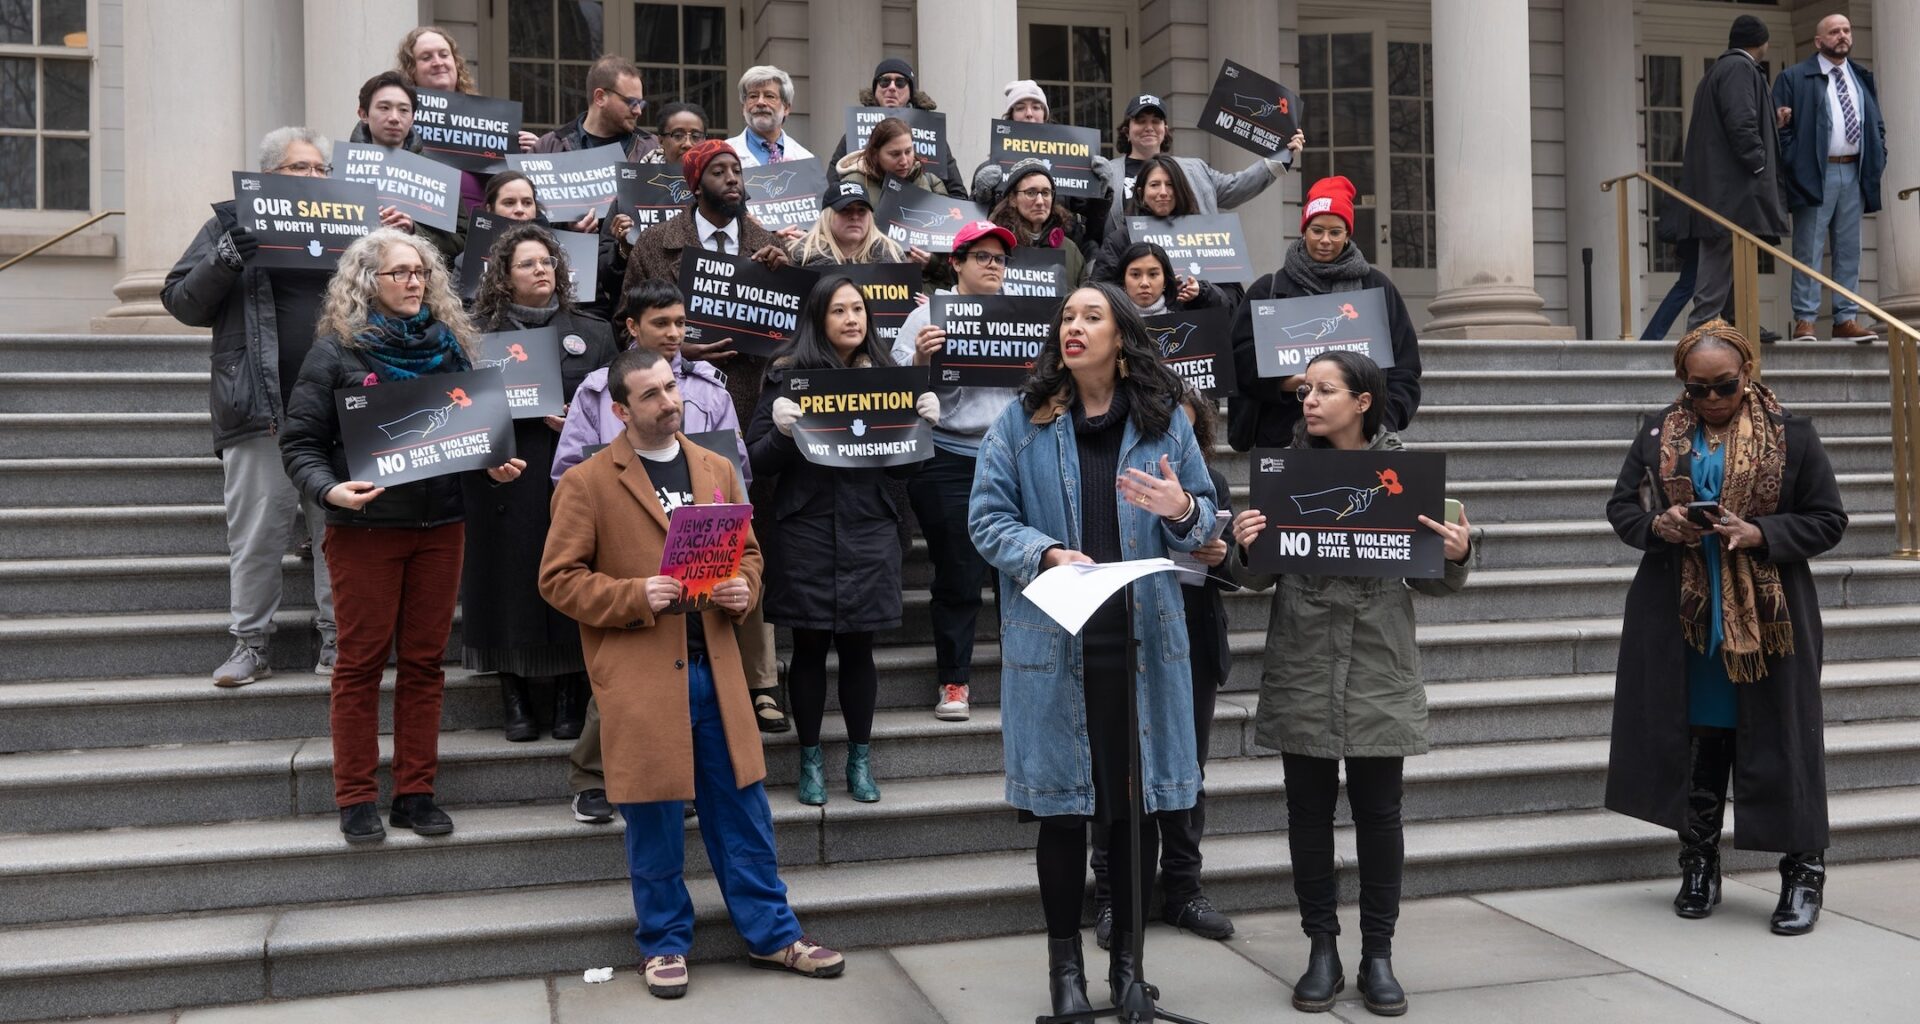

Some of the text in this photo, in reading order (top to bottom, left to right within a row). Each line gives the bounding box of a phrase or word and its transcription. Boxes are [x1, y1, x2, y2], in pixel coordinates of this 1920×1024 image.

[414, 109, 509, 134] HATE VIOLENCE
[1215, 111, 1234, 129] NO
[1232, 126, 1278, 151] STATE VIOLENCE
[1236, 118, 1281, 145] HATE VIOLENCE
[347, 149, 384, 162] FUND
[1003, 138, 1089, 157] PREVENTION
[520, 160, 553, 172] FUND
[560, 165, 616, 184] VIOLENCE
[346, 163, 447, 193] HATE VIOLENCE
[253, 198, 365, 221] OUR SAFETY
[765, 197, 816, 214] PROTECT
[638, 209, 659, 223] WE
[783, 210, 820, 224] OTHER
[255, 219, 369, 236] IS WORTH FUNDING
[888, 224, 907, 241] NO
[1143, 232, 1231, 247] OUR SAFETY
[1196, 248, 1236, 258] FUNDING
[696, 257, 735, 277] FUND
[693, 276, 800, 310] HATE VIOLENCE
[690, 295, 797, 331] PREVENTION
[945, 303, 983, 316] FUND
[946, 320, 1051, 337] HATE VIOLENCE
[946, 339, 1044, 358] PREVENTIO
[1278, 348, 1301, 365] NO
[800, 391, 913, 414] PREVENTION
[409, 433, 489, 459] HATE VIOLENCE
[807, 439, 918, 457] NOT PUNISHMENT
[376, 453, 406, 476] NO
[411, 444, 491, 468] STATE VIOLENCE
[677, 518, 744, 533] JEWS FOR
[672, 533, 738, 549] RACIAL &
[1280, 532, 1311, 557] NO
[1317, 532, 1411, 547] HATE VIOLENCE
[668, 549, 737, 565] ECONOMIC
[1317, 546, 1411, 560] STATE VIOLENCE
[681, 564, 733, 580] JUSTICE
